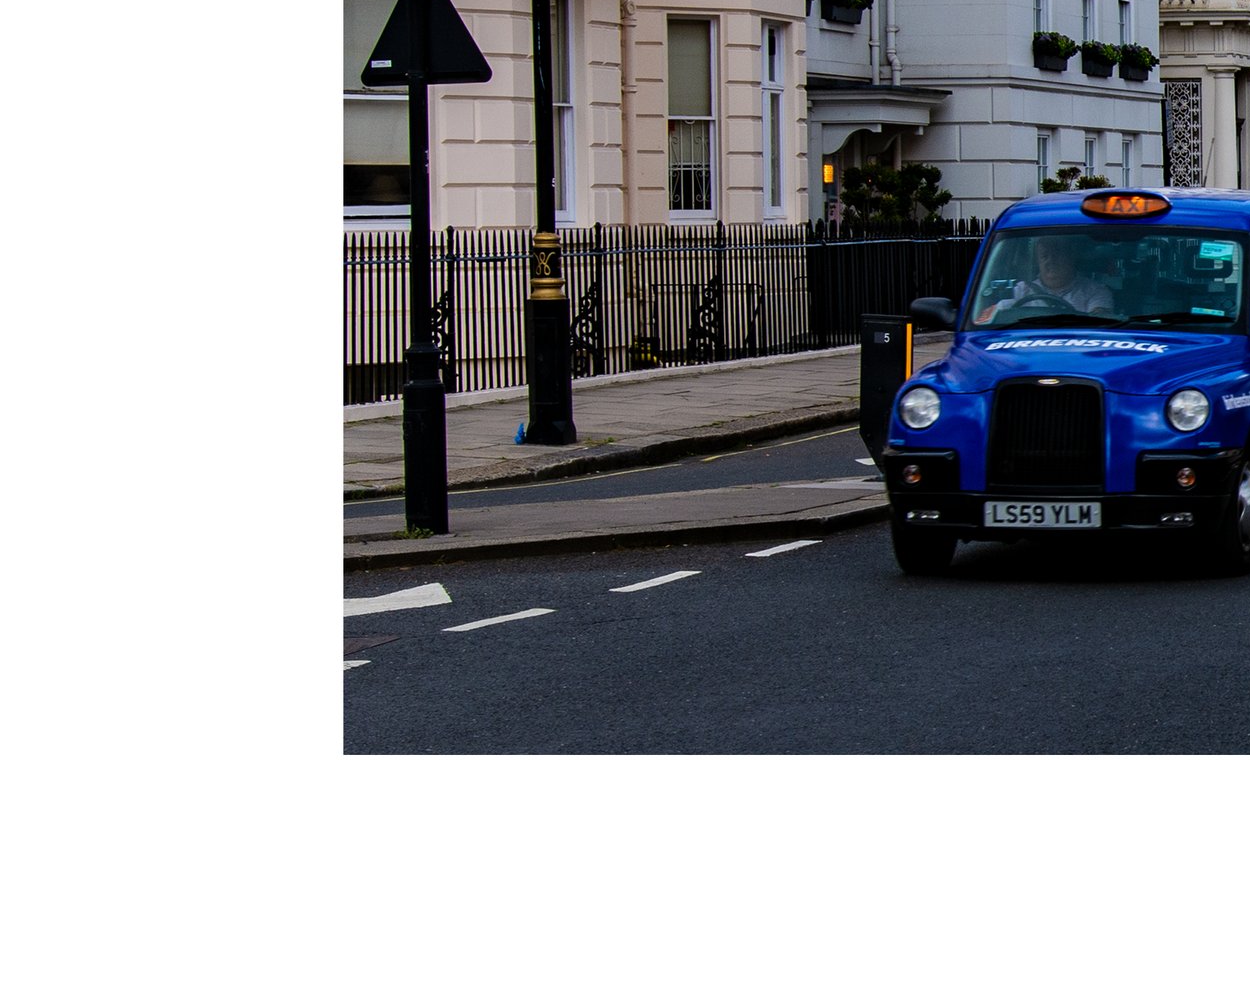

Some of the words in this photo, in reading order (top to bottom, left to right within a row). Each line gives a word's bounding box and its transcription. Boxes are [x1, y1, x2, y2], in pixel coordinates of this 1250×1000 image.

[1100, 198, 1151, 213] TAXI
[884, 332, 890, 343] 5
[985, 339, 1169, 353] BIRKENSTOCK
[991, 504, 1046, 524] LS59
[1051, 504, 1092, 524] YLM
